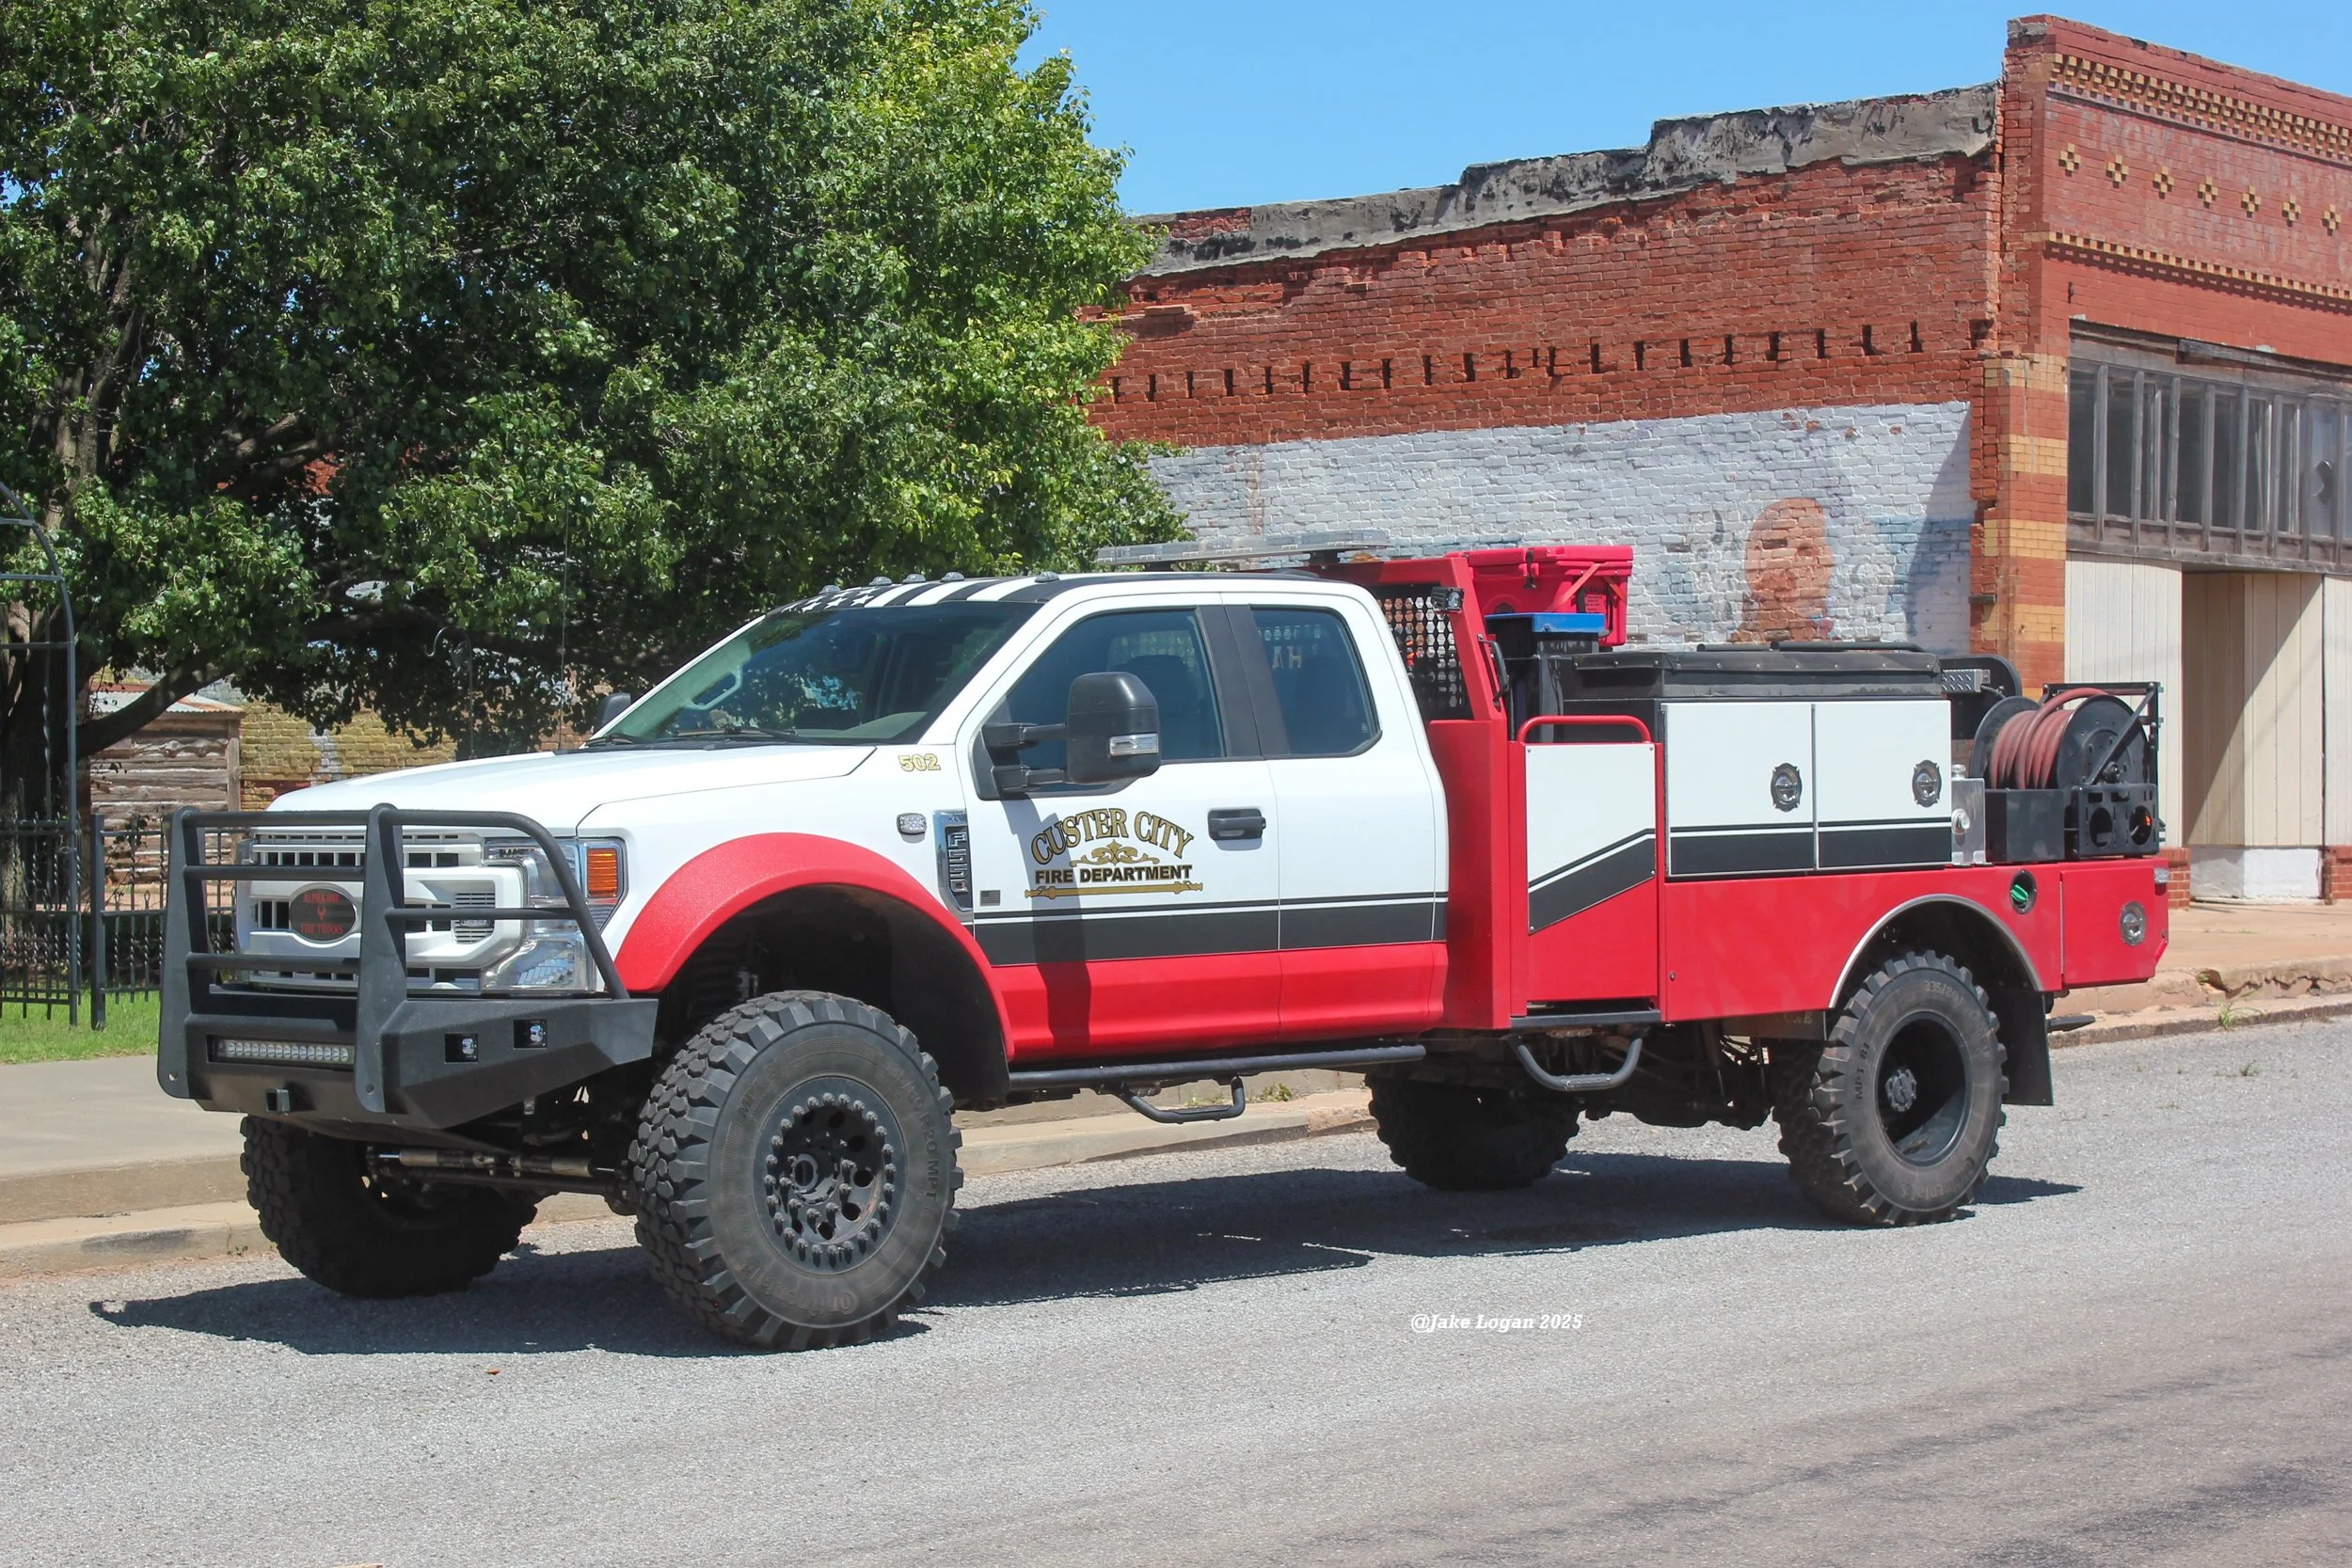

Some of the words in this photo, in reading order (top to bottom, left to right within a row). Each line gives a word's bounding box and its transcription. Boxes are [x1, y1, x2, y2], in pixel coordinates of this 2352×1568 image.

[898, 753, 941, 771] 502
[1031, 808, 1128, 864] CUSTER
[1134, 811, 1195, 859] CITY
[1035, 869, 1073, 884] FIRE
[1080, 864, 1193, 883] DEPARTMENT
[927, 1158, 940, 1201] MPT
